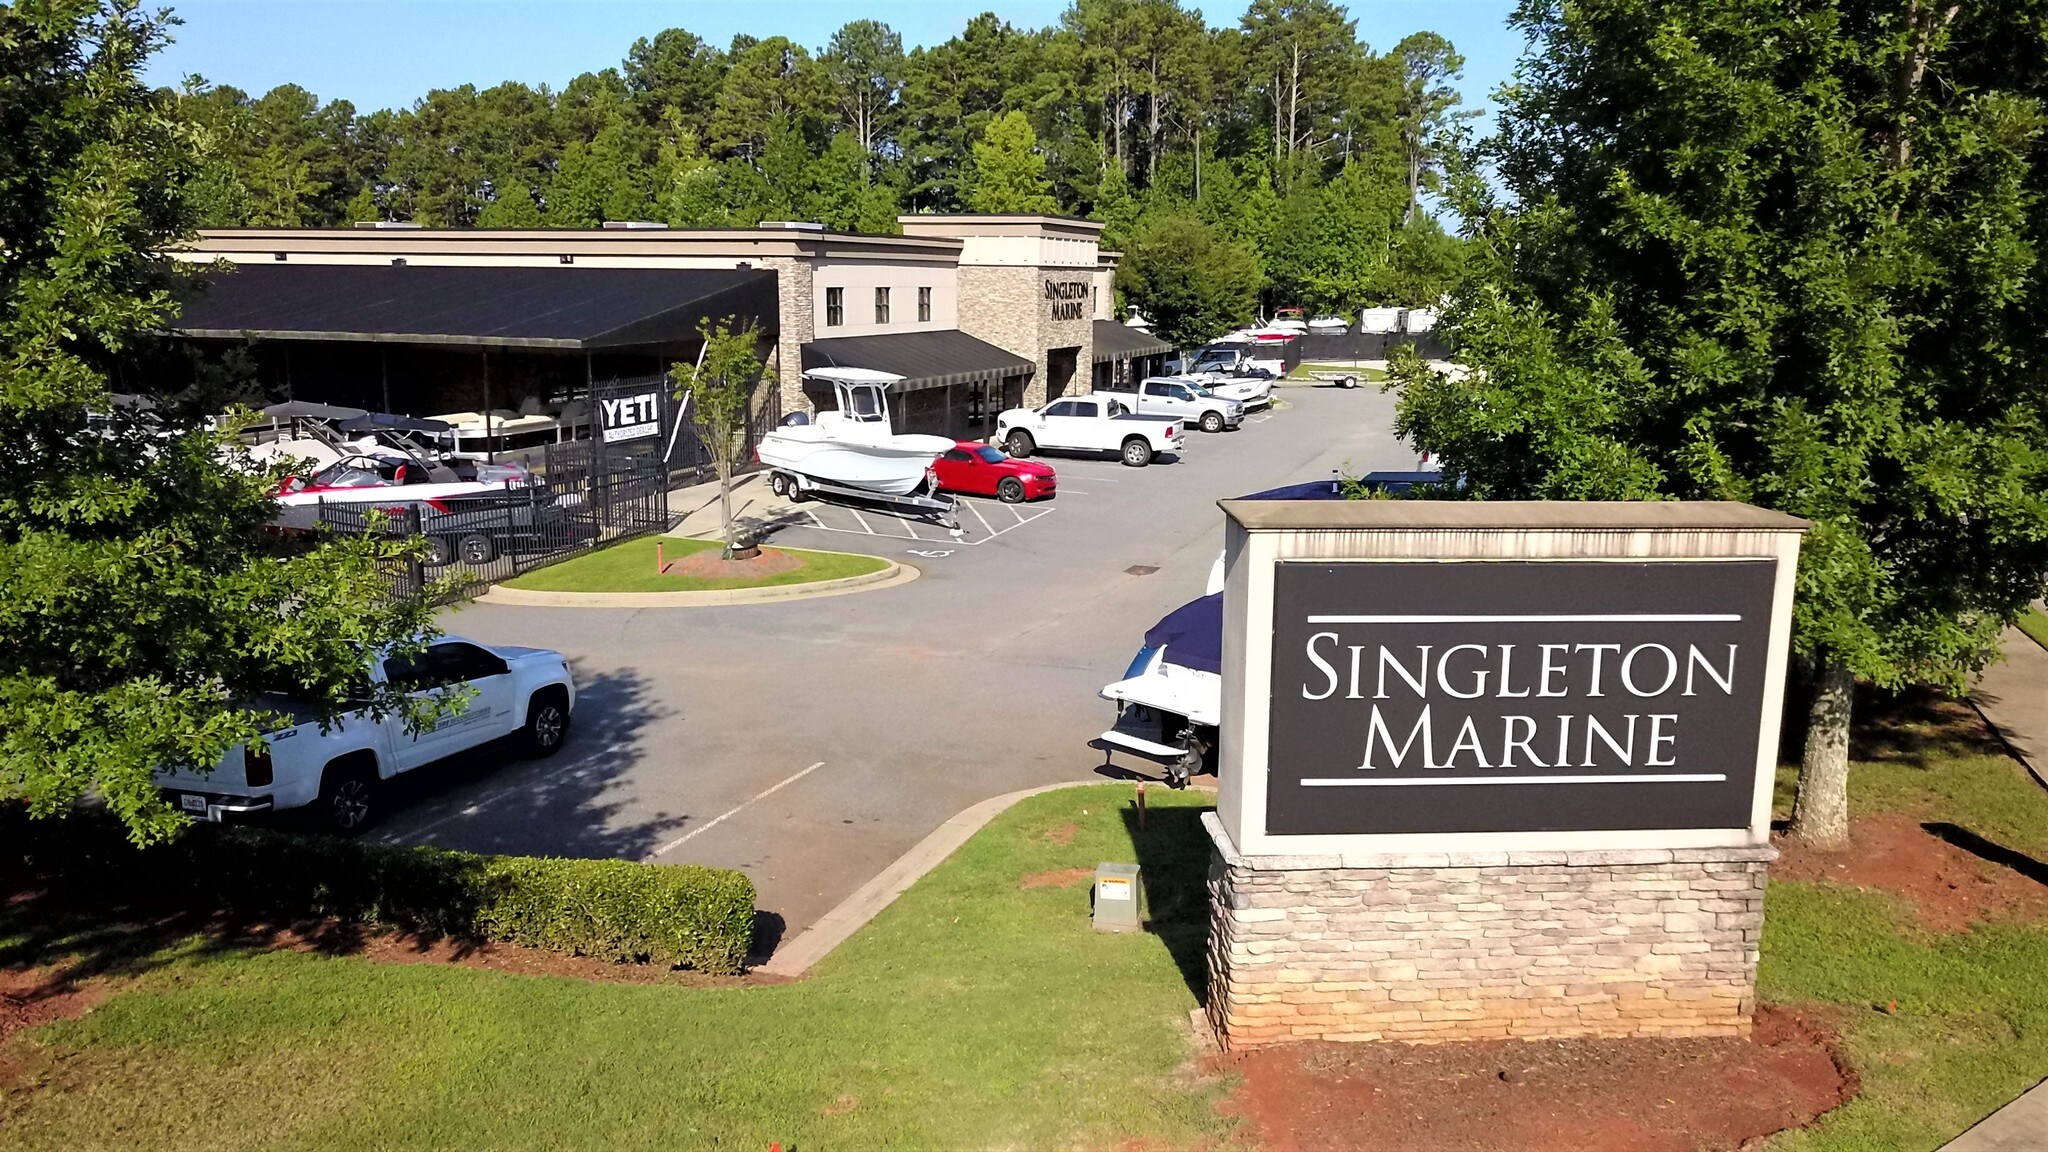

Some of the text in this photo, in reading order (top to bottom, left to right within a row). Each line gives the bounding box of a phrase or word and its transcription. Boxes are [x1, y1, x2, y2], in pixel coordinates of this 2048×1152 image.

[1044, 279, 1088, 300] SINGLETON
[1051, 301, 1082, 321] MARINE
[602, 393, 657, 427] YETI
[1302, 631, 1739, 701] SINGLETON
[1356, 703, 1679, 770] MARINE
